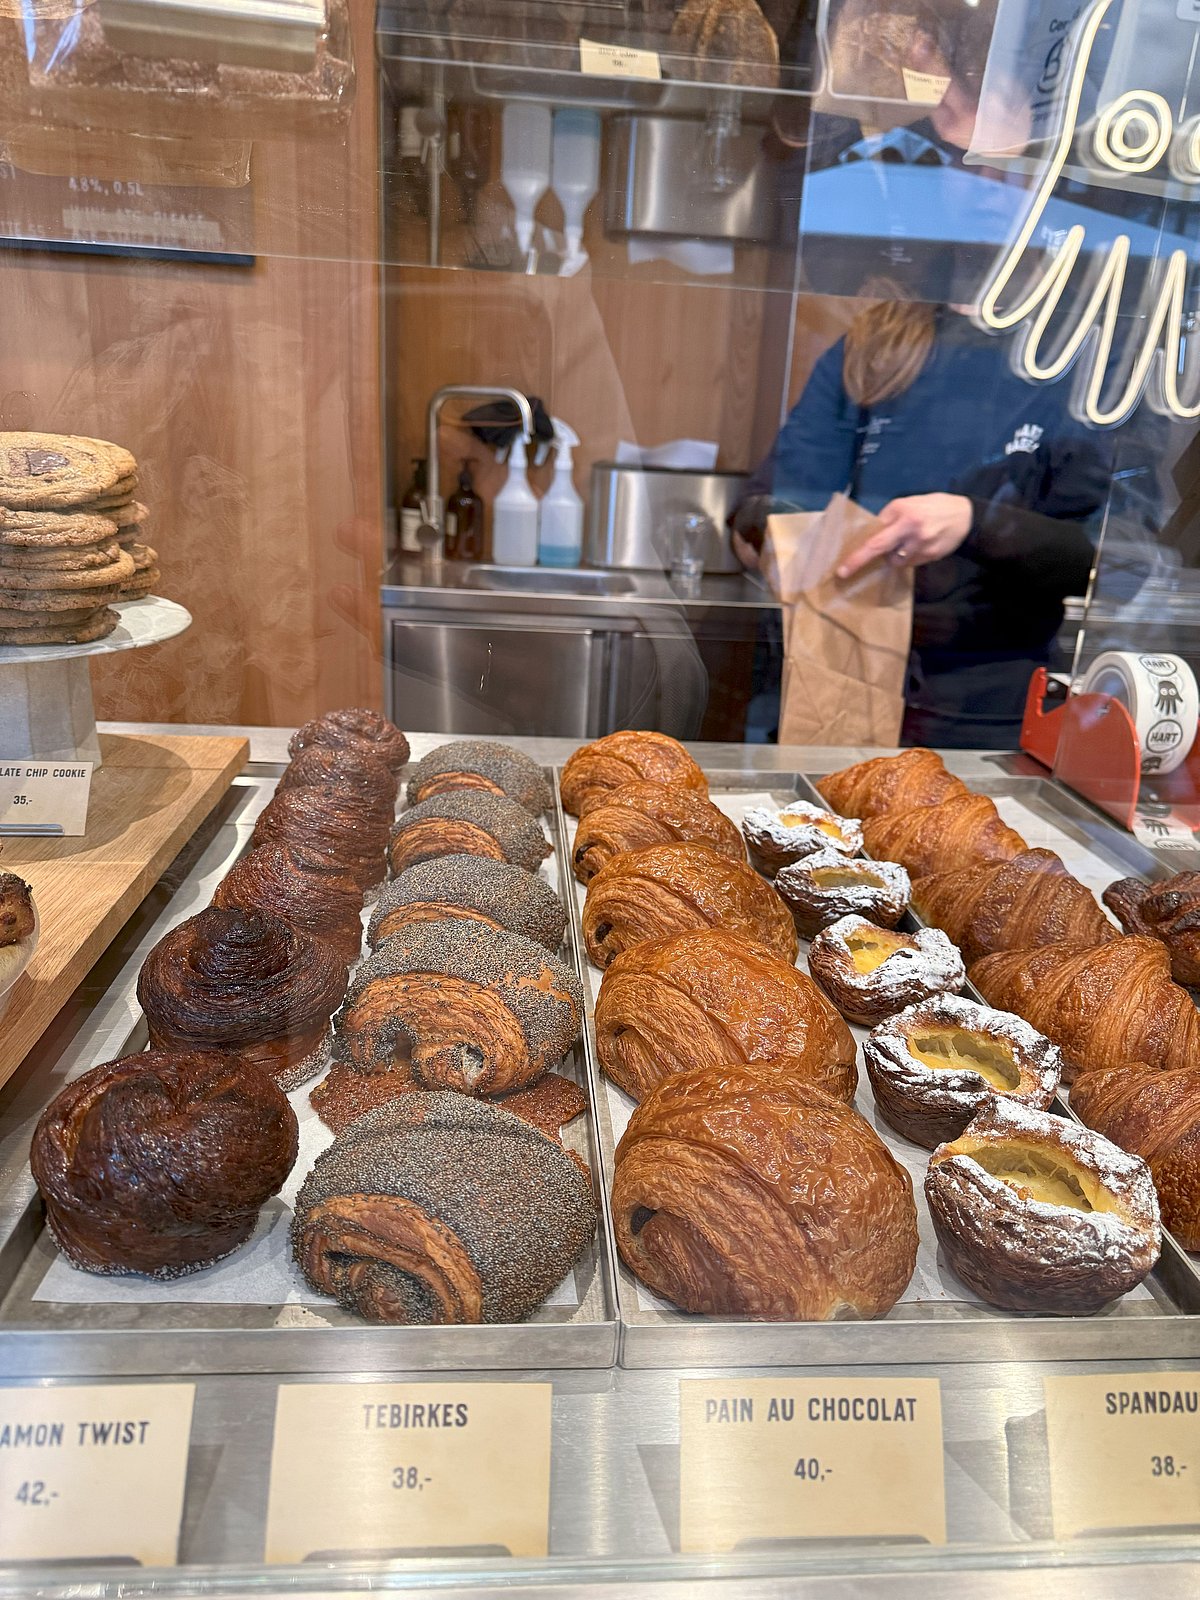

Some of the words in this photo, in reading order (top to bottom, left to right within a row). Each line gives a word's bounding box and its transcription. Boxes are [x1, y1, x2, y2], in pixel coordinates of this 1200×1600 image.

[1150, 732, 1178, 743] HART
[26, 768, 48, 777] CHIP
[53, 769, 86, 778] COOKIE
[705, 1398, 753, 1423] PAIN
[767, 1399, 795, 1421] AU
[808, 1398, 917, 1422] CHOCOLAT
[1105, 1391, 1199, 1415] SPANDAU
[363, 1403, 468, 1429] TEBIRKES
[79, 1421, 150, 1446] TWIST
[392, 1466, 432, 1491] 38,-
[794, 1458, 833, 1482] 40,-
[1151, 1455, 1187, 1478] 38,-
